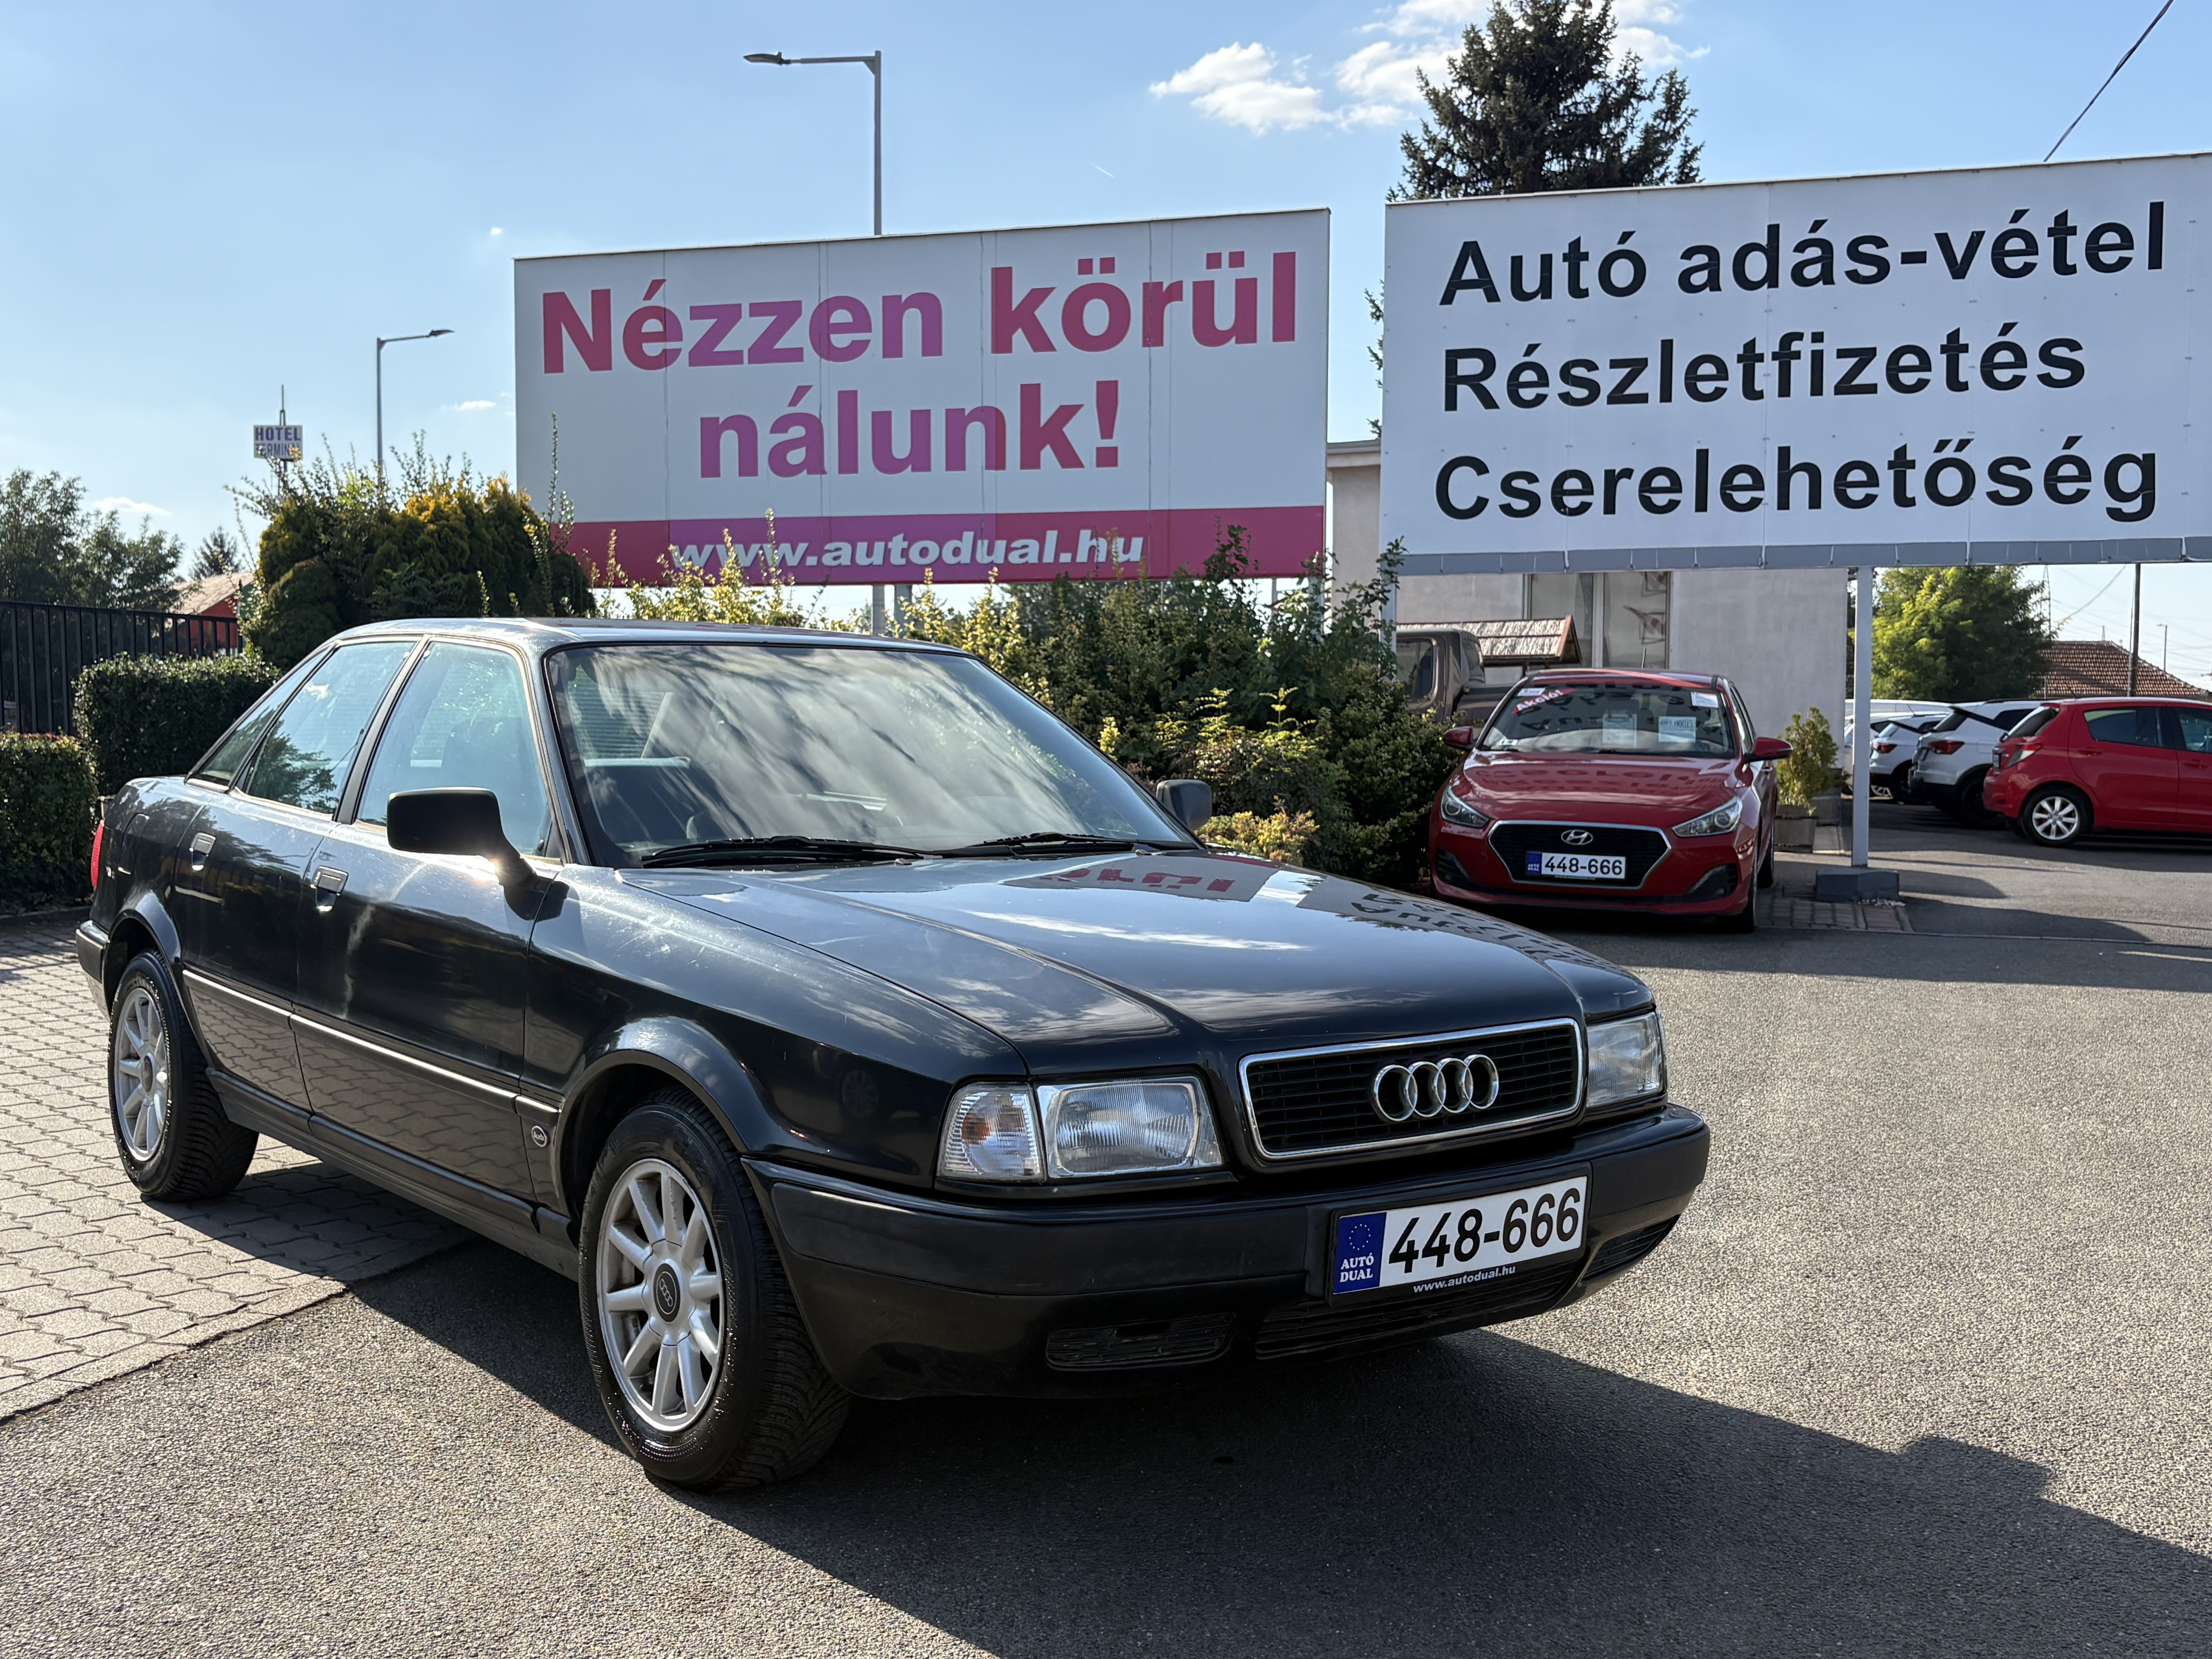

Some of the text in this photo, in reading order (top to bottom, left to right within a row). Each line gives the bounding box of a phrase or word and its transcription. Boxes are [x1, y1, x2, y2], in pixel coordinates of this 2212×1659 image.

[1439, 201, 2164, 305] Autó adás-vétel
[544, 252, 1295, 373] Nézzen körül
[1445, 322, 2084, 411] Részletfizetés
[256, 427, 301, 441] HOTEL
[701, 381, 1118, 477] nálunk!
[256, 443, 300, 456] RMIN
[1436, 436, 2155, 522] Cserelehetőség
[670, 529, 1143, 568] www.autodual.hu
[1544, 855, 1622, 876] 448-666
[1389, 1188, 1580, 1274] 448-666
[1340, 1252, 1374, 1270] AUTÓ
[1340, 1268, 1374, 1283] DUAL
[1413, 1266, 1516, 1293] www.autodual.hu
